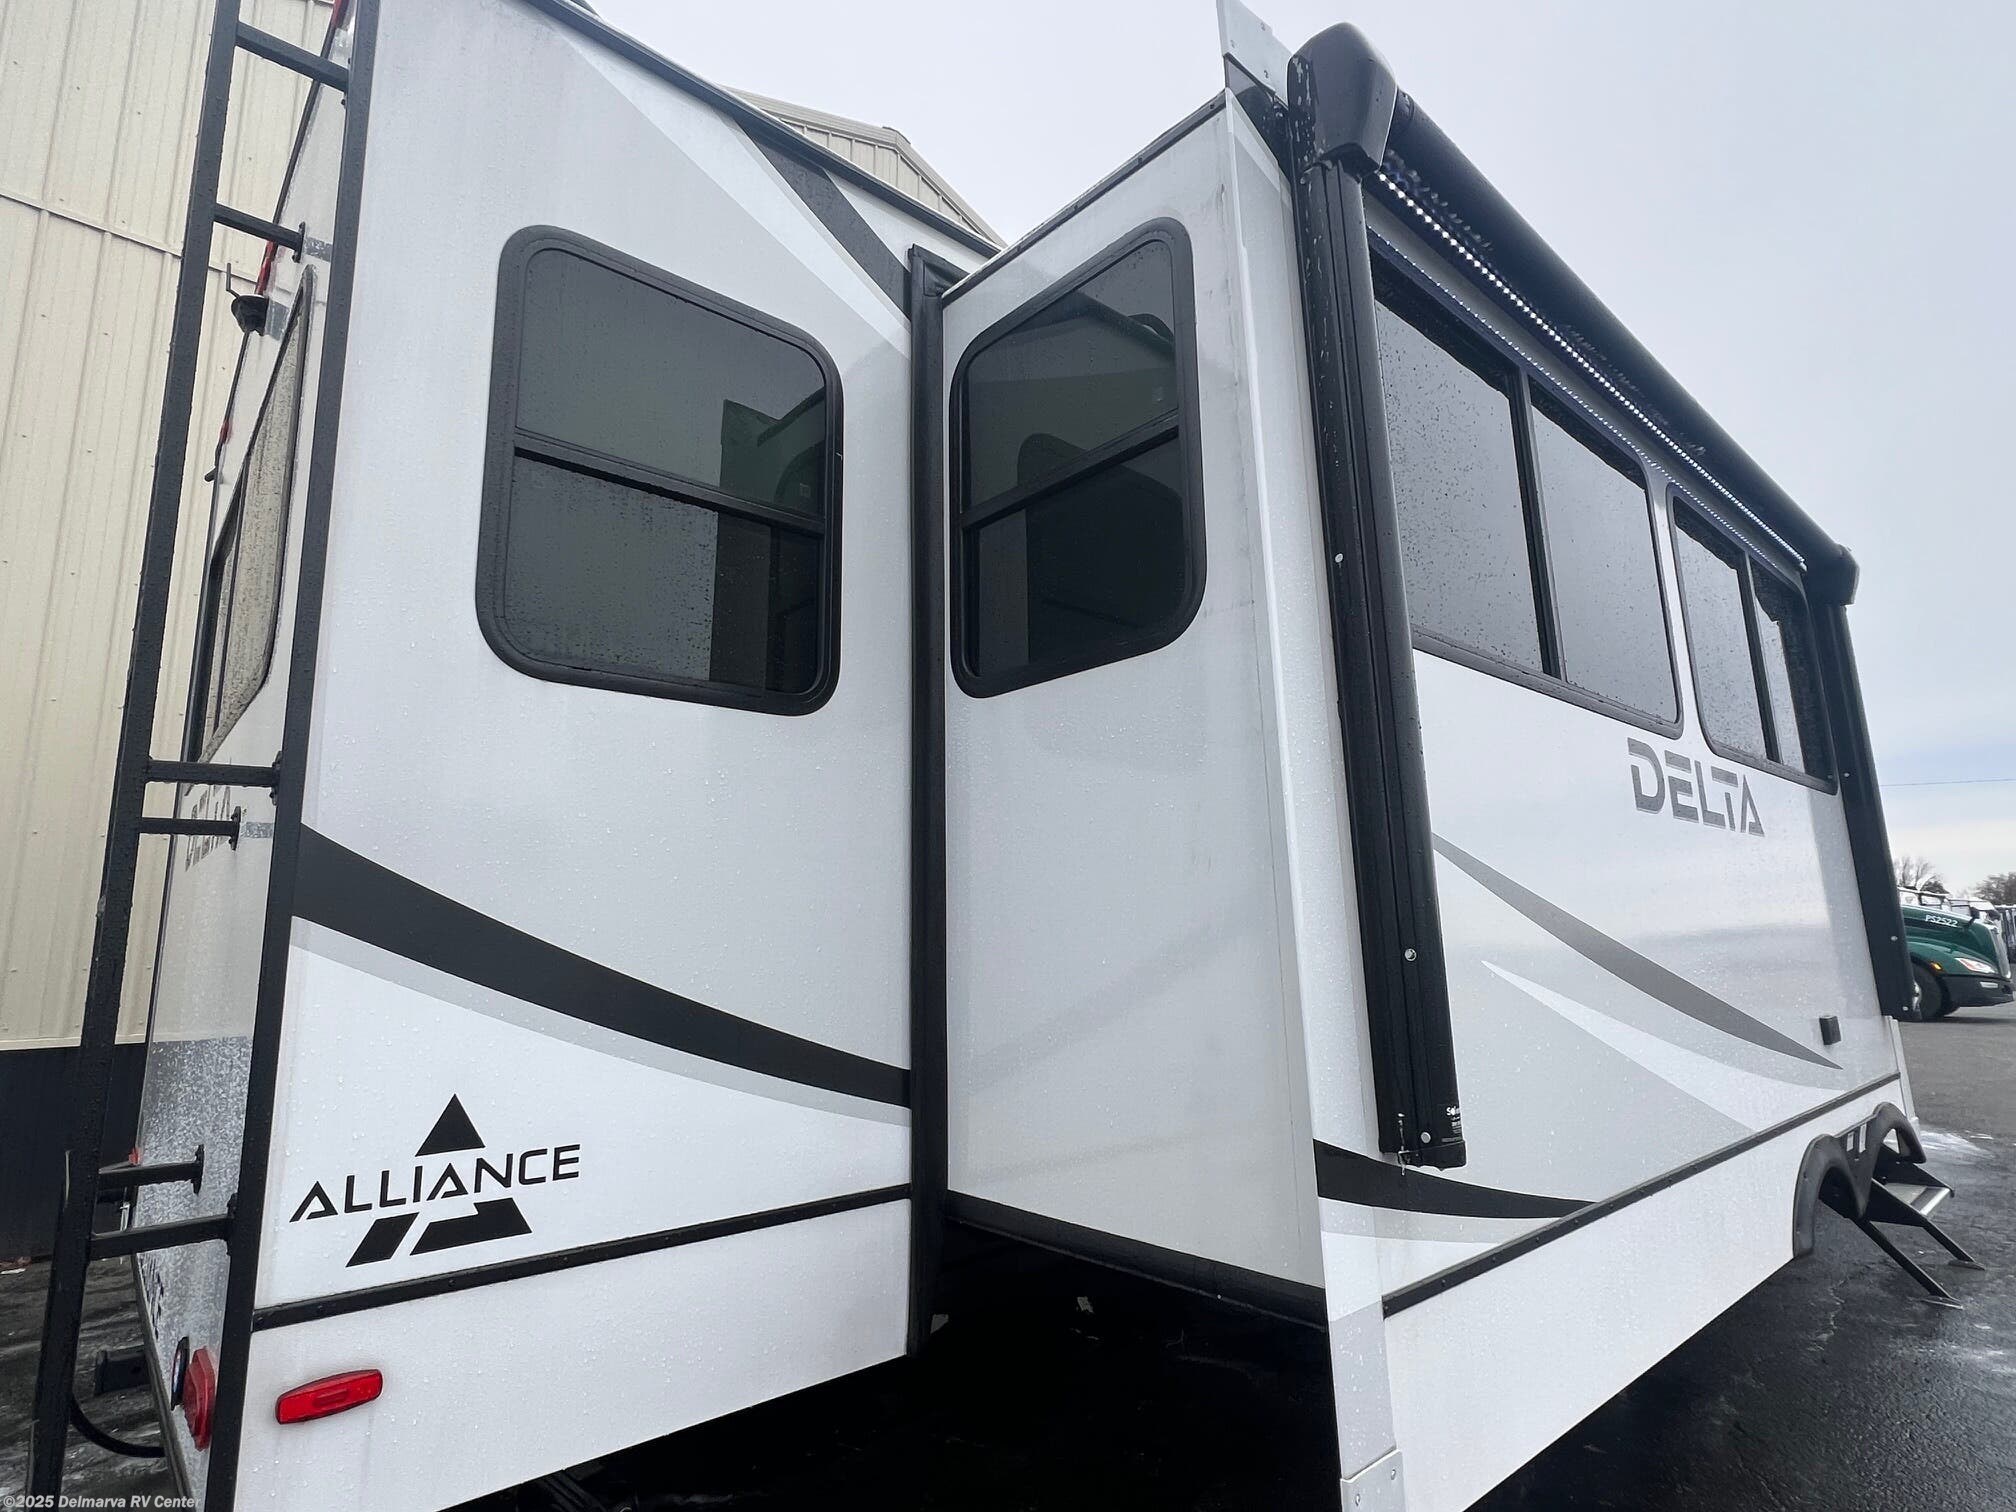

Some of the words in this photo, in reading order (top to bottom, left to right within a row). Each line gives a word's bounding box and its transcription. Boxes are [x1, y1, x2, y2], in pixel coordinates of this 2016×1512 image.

[1627, 737, 1765, 837] DELTA
[1925, 914, 1959, 928] PS2522
[289, 1144, 581, 1223] ALLIANCE
